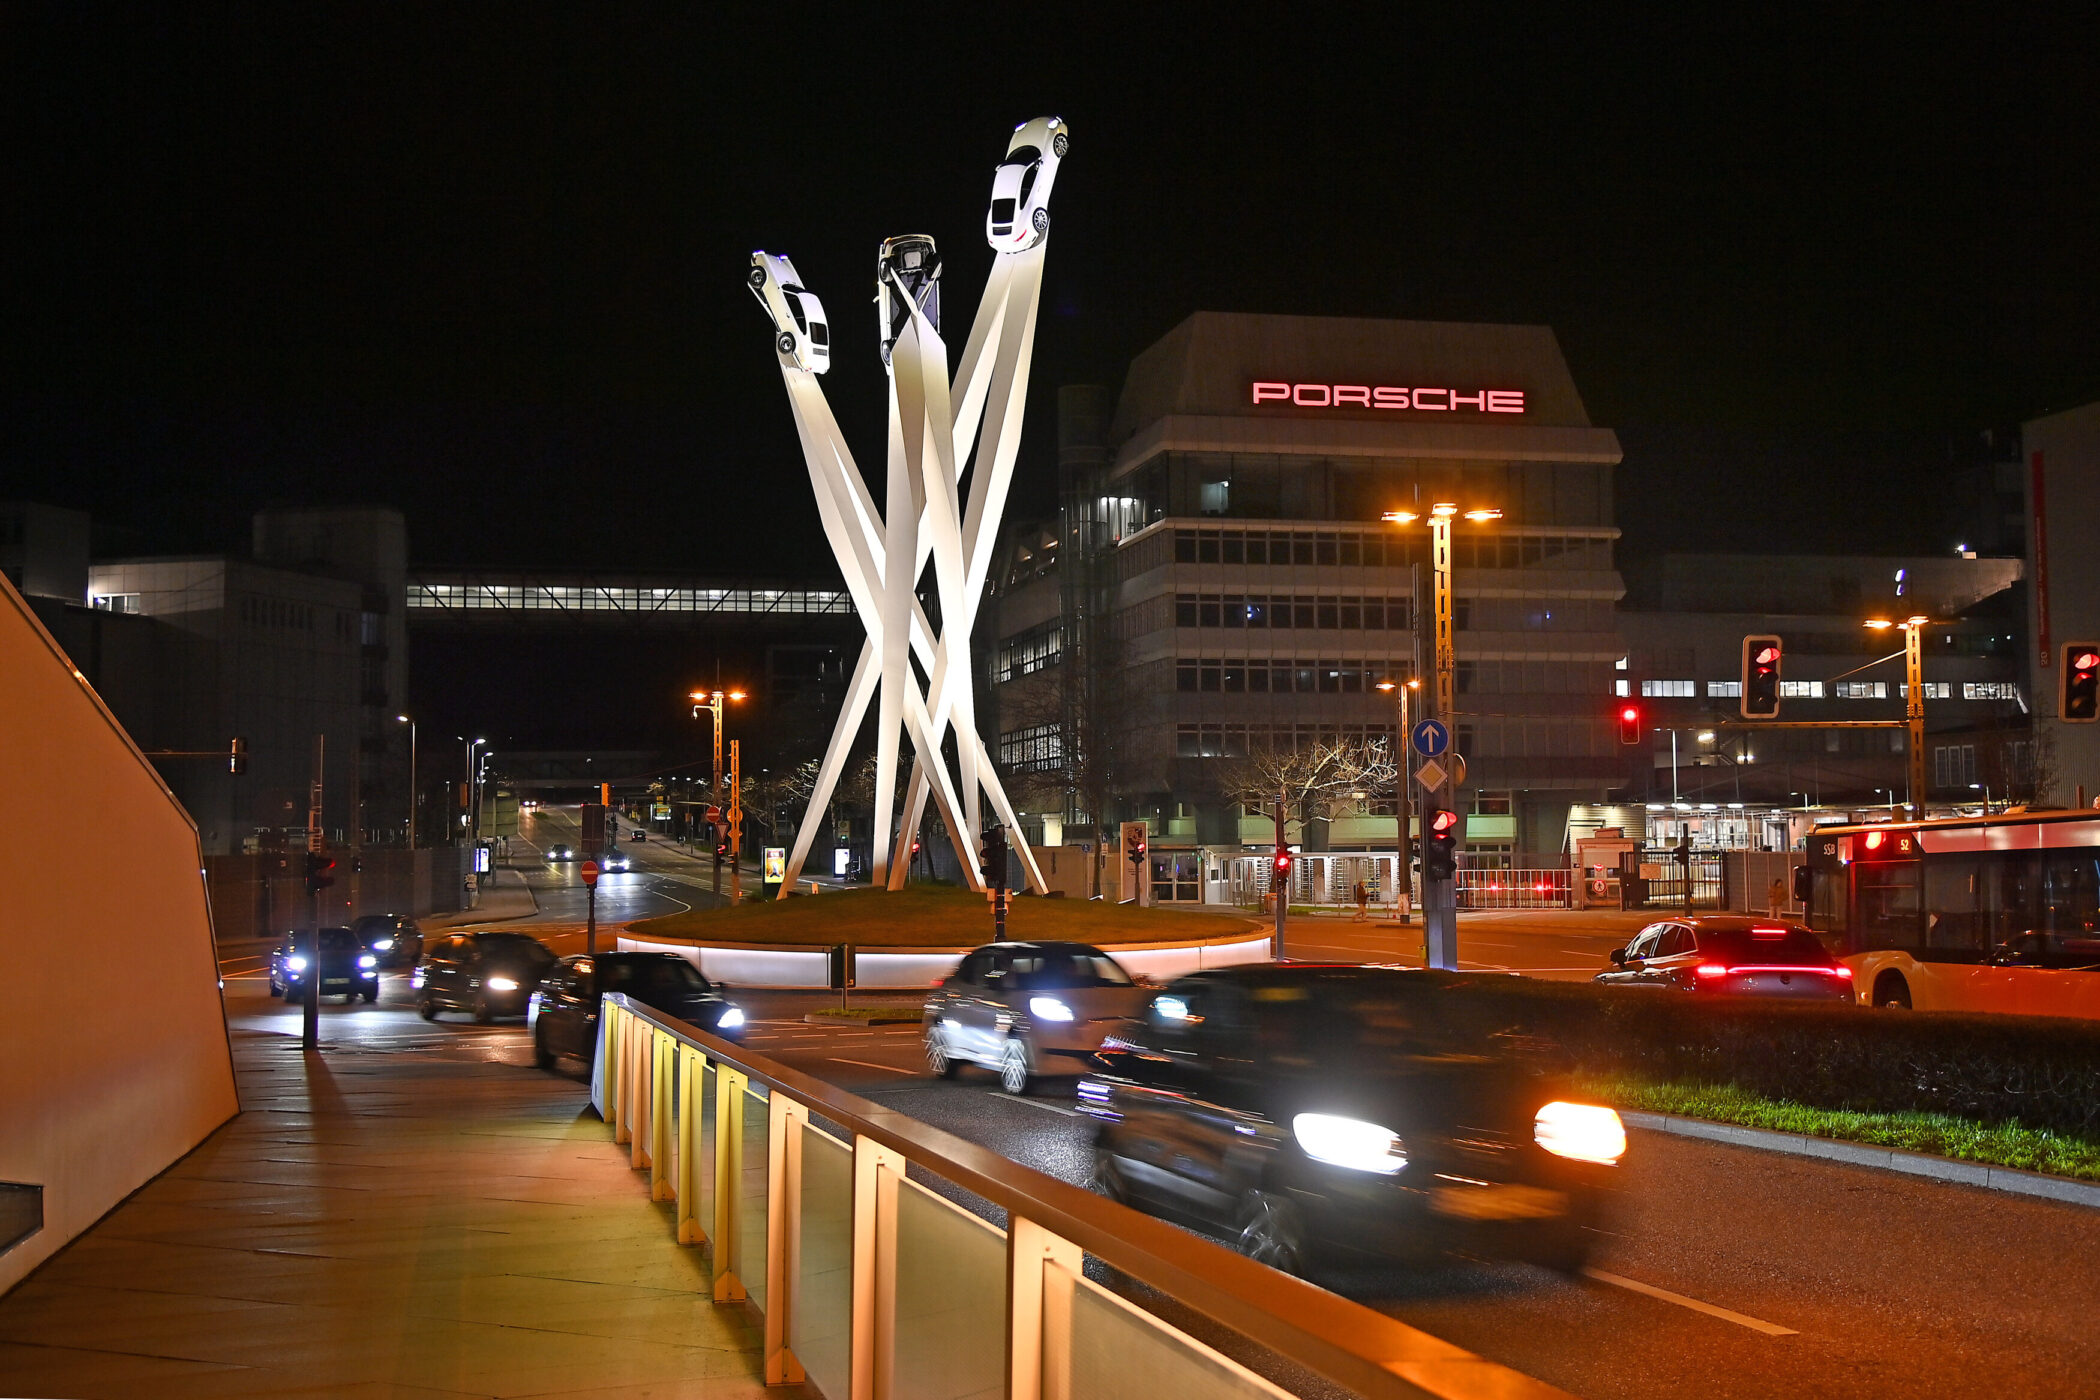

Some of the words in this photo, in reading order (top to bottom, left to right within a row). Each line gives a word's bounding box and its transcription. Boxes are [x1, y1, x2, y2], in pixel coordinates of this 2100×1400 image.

[1252, 382, 1524, 413] PORSCHE
[1823, 843, 1835, 855] SSB
[1900, 839, 1909, 850] 52
